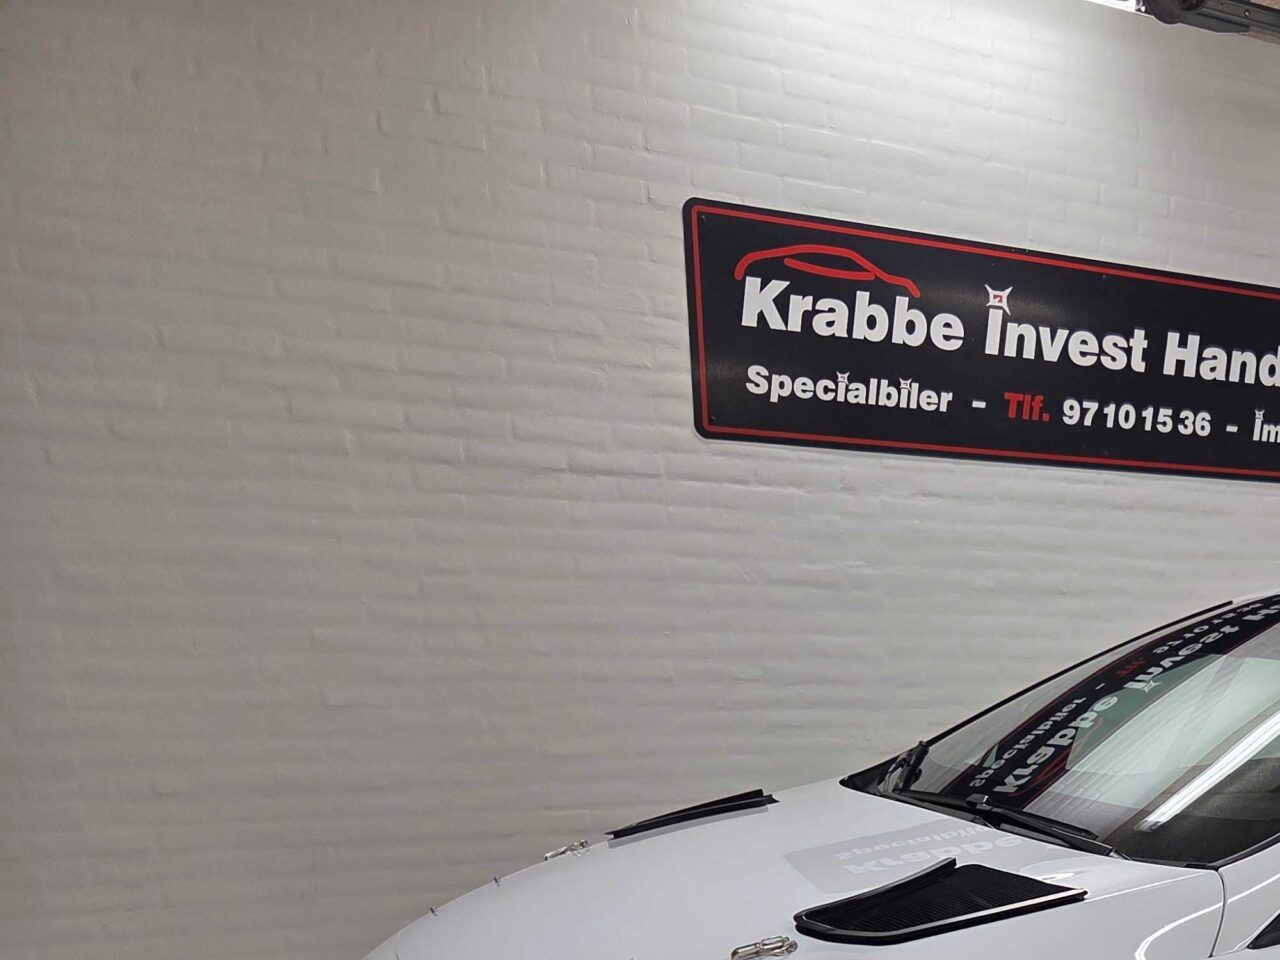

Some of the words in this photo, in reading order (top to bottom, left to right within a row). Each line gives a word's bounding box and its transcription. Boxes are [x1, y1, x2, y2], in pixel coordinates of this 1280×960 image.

[741, 276, 965, 351] Krabbe
[985, 284, 1149, 373] Invest
[745, 364, 953, 413] Specialbiler
[1004, 391, 1050, 422] Tlf.
